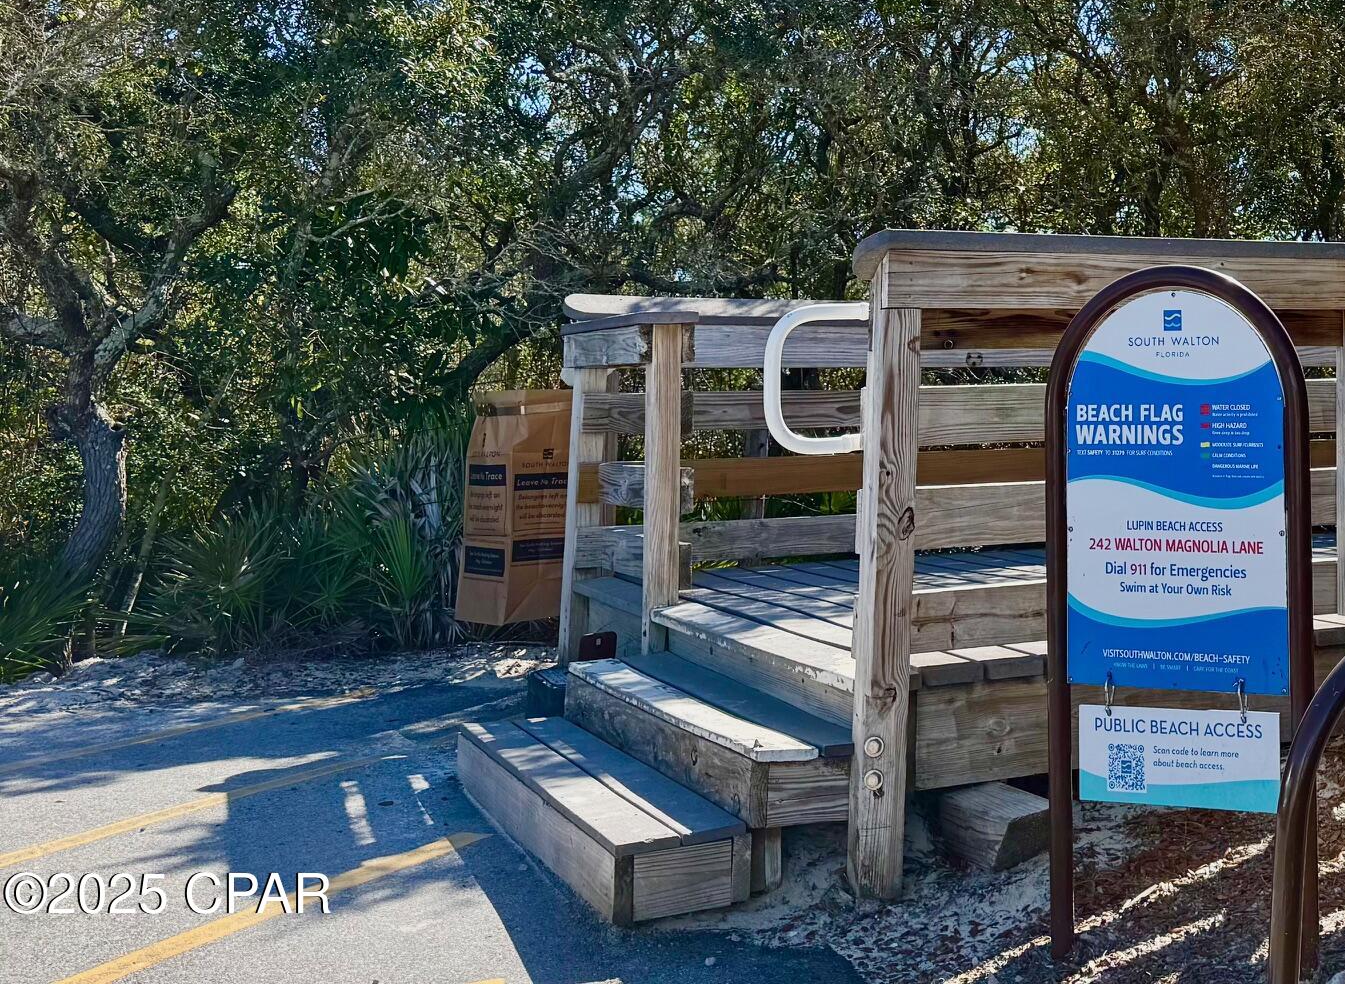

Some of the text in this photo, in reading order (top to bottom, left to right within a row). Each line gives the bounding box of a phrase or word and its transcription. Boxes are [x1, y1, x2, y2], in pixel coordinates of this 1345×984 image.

[1128, 336, 1220, 347] SOUTH WALTON
[1076, 404, 1184, 422] BEACH FLAG
[1075, 424, 1184, 445] WARNINGS
[485, 472, 503, 480] Trace
[517, 479, 539, 487] Leave
[551, 477, 567, 485] Trac
[1126, 520, 1223, 533] LUPIN BEACH ACCESS
[1089, 537, 1264, 555] 242 WALTON MAGNOLIA LANE
[1105, 561, 1247, 582] Dial 911 for Emergencies
[1120, 582, 1232, 596] Swim at Your Own Risk
[1102, 648, 1251, 665] VISITSOUTHWALTON.COM/BEACH-SAFETY
[1095, 717, 1263, 739] PUBLIC BEACH ACCESS
[1153, 745, 1239, 758] Scan code to learn more
[1153, 759, 1225, 771] about beach access.
